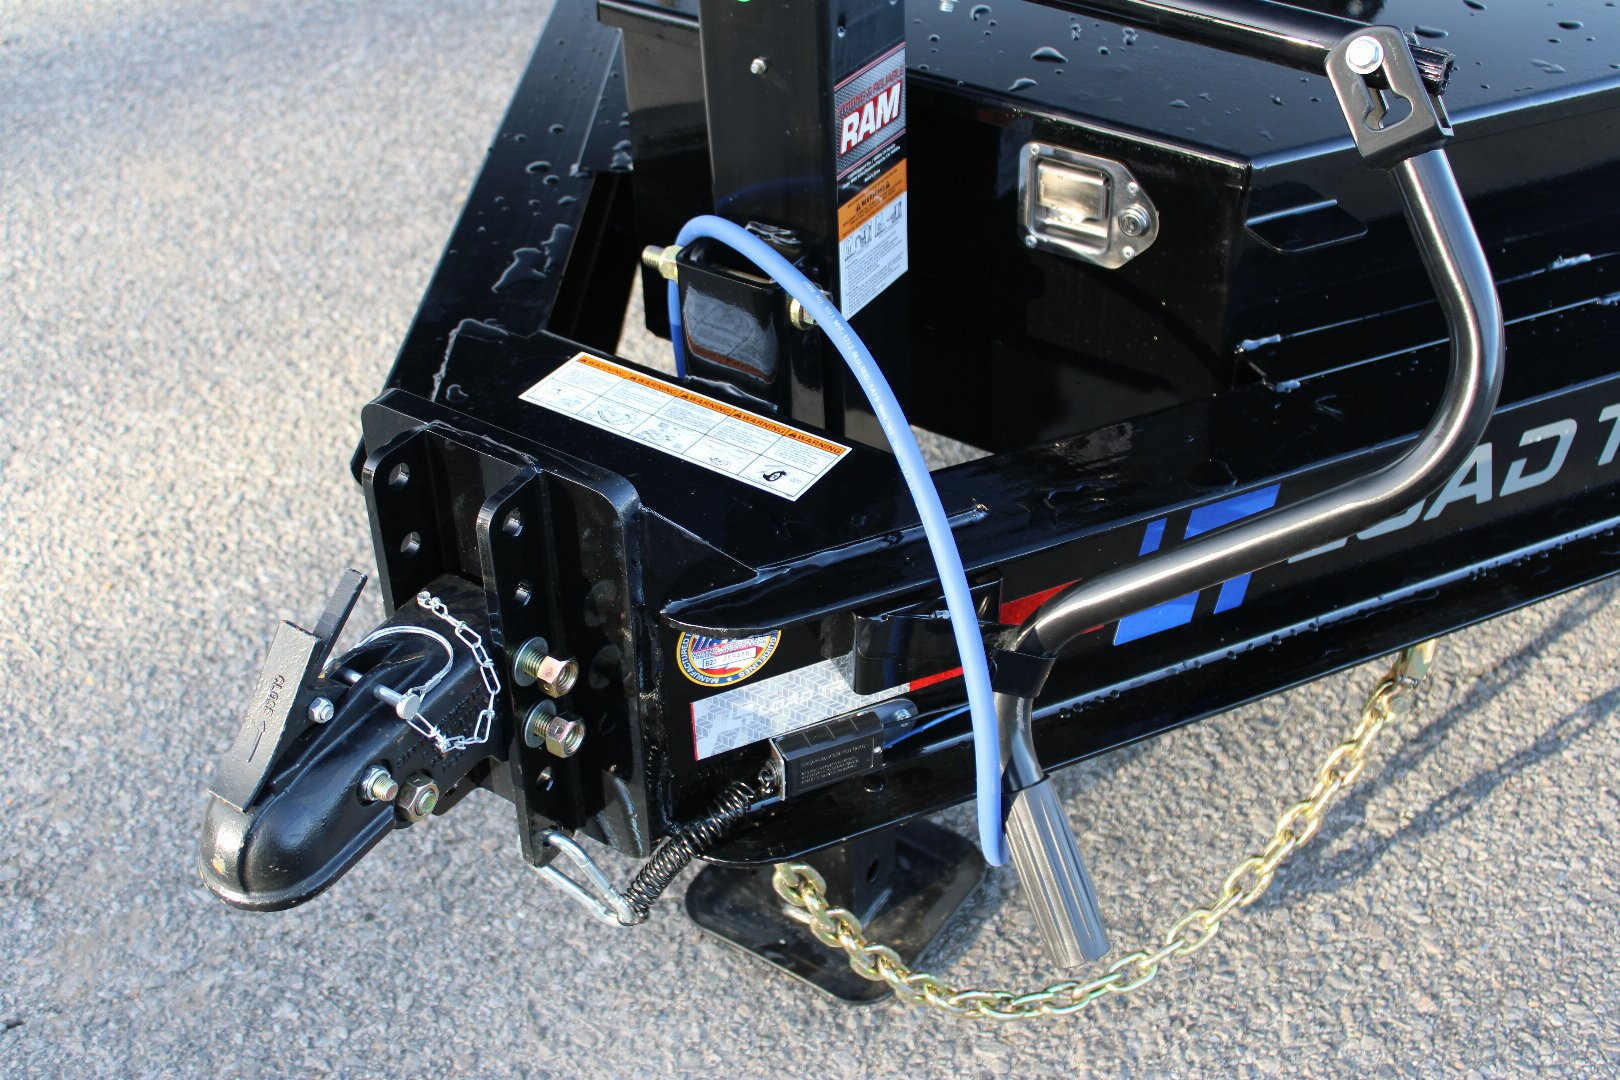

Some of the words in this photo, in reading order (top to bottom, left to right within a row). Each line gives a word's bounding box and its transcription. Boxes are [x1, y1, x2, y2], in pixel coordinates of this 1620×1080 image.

[840, 82, 901, 154] RAM
[637, 378, 678, 396] WARNING
[689, 395, 730, 414] WARNING
[741, 414, 786, 434] WARNING
[797, 434, 842, 454] WARNING
[681, 638, 720, 684] MANUFACTURED
[739, 637, 777, 678] GUIDELINES
[265, 674, 285, 718] CLOSE
